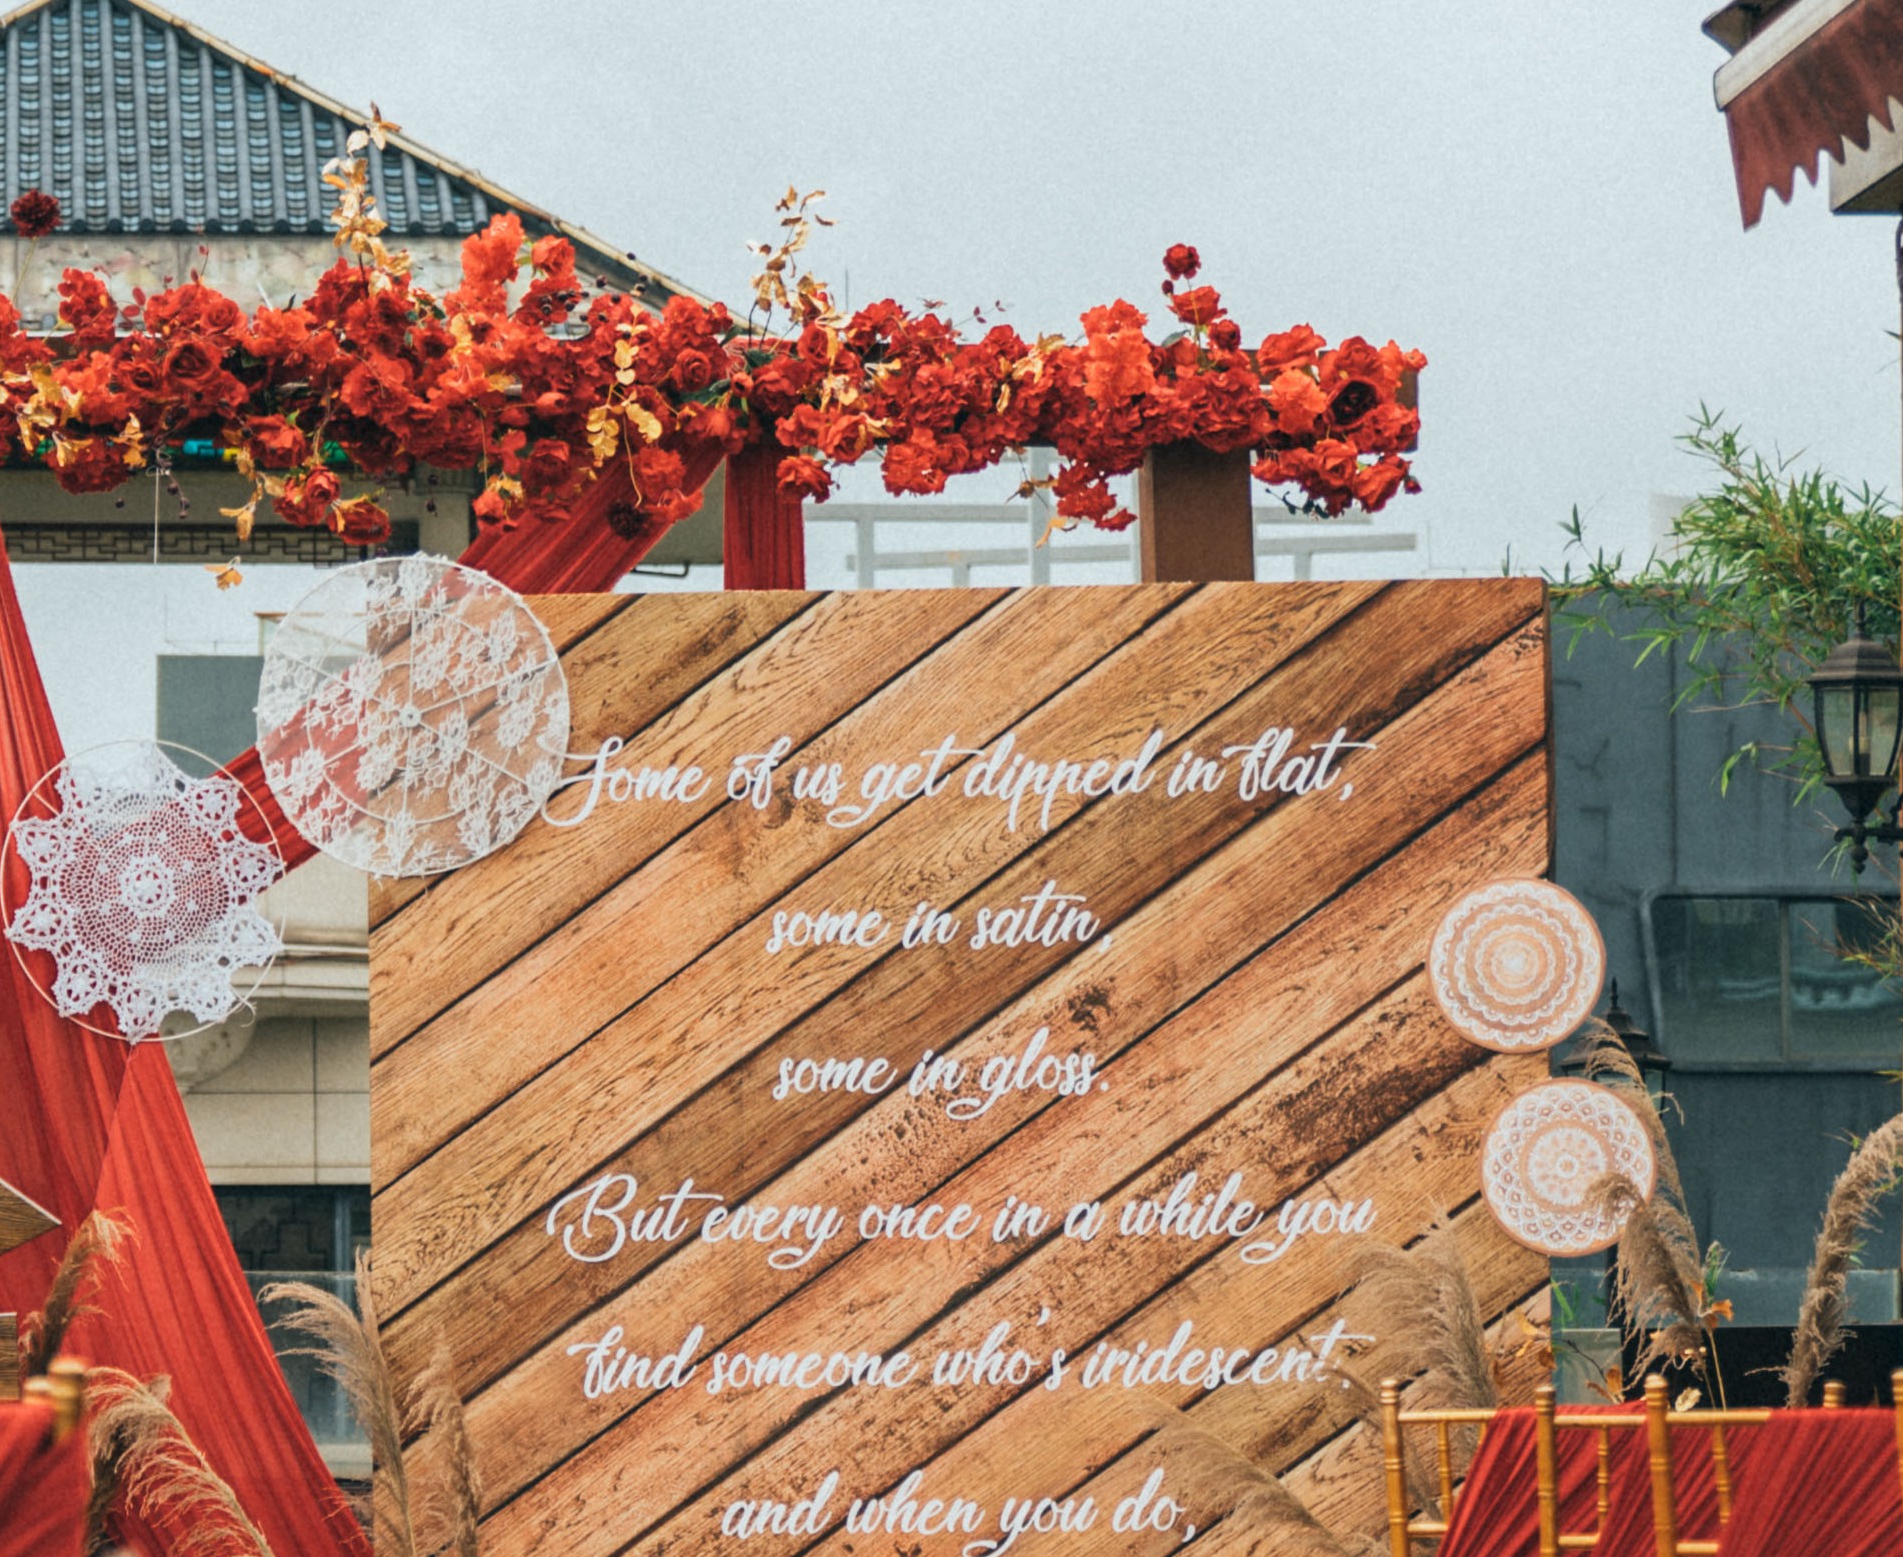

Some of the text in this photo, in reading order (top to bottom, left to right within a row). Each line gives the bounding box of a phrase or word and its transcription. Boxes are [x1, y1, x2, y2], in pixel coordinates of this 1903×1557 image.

[539, 726, 1377, 832] Some of us get dipped in flat,
[765, 879, 1114, 954] some in satin,
[771, 1026, 1109, 1121] some in gloss.
[545, 1170, 1378, 1270] But every once in a while you
[566, 1325, 704, 1399] find
[706, 1350, 919, 1395] someone
[932, 1307, 1069, 1391] who's
[720, 1470, 839, 1540] and
[844, 1469, 985, 1535] when
[1111, 1467, 1196, 1543] do,
